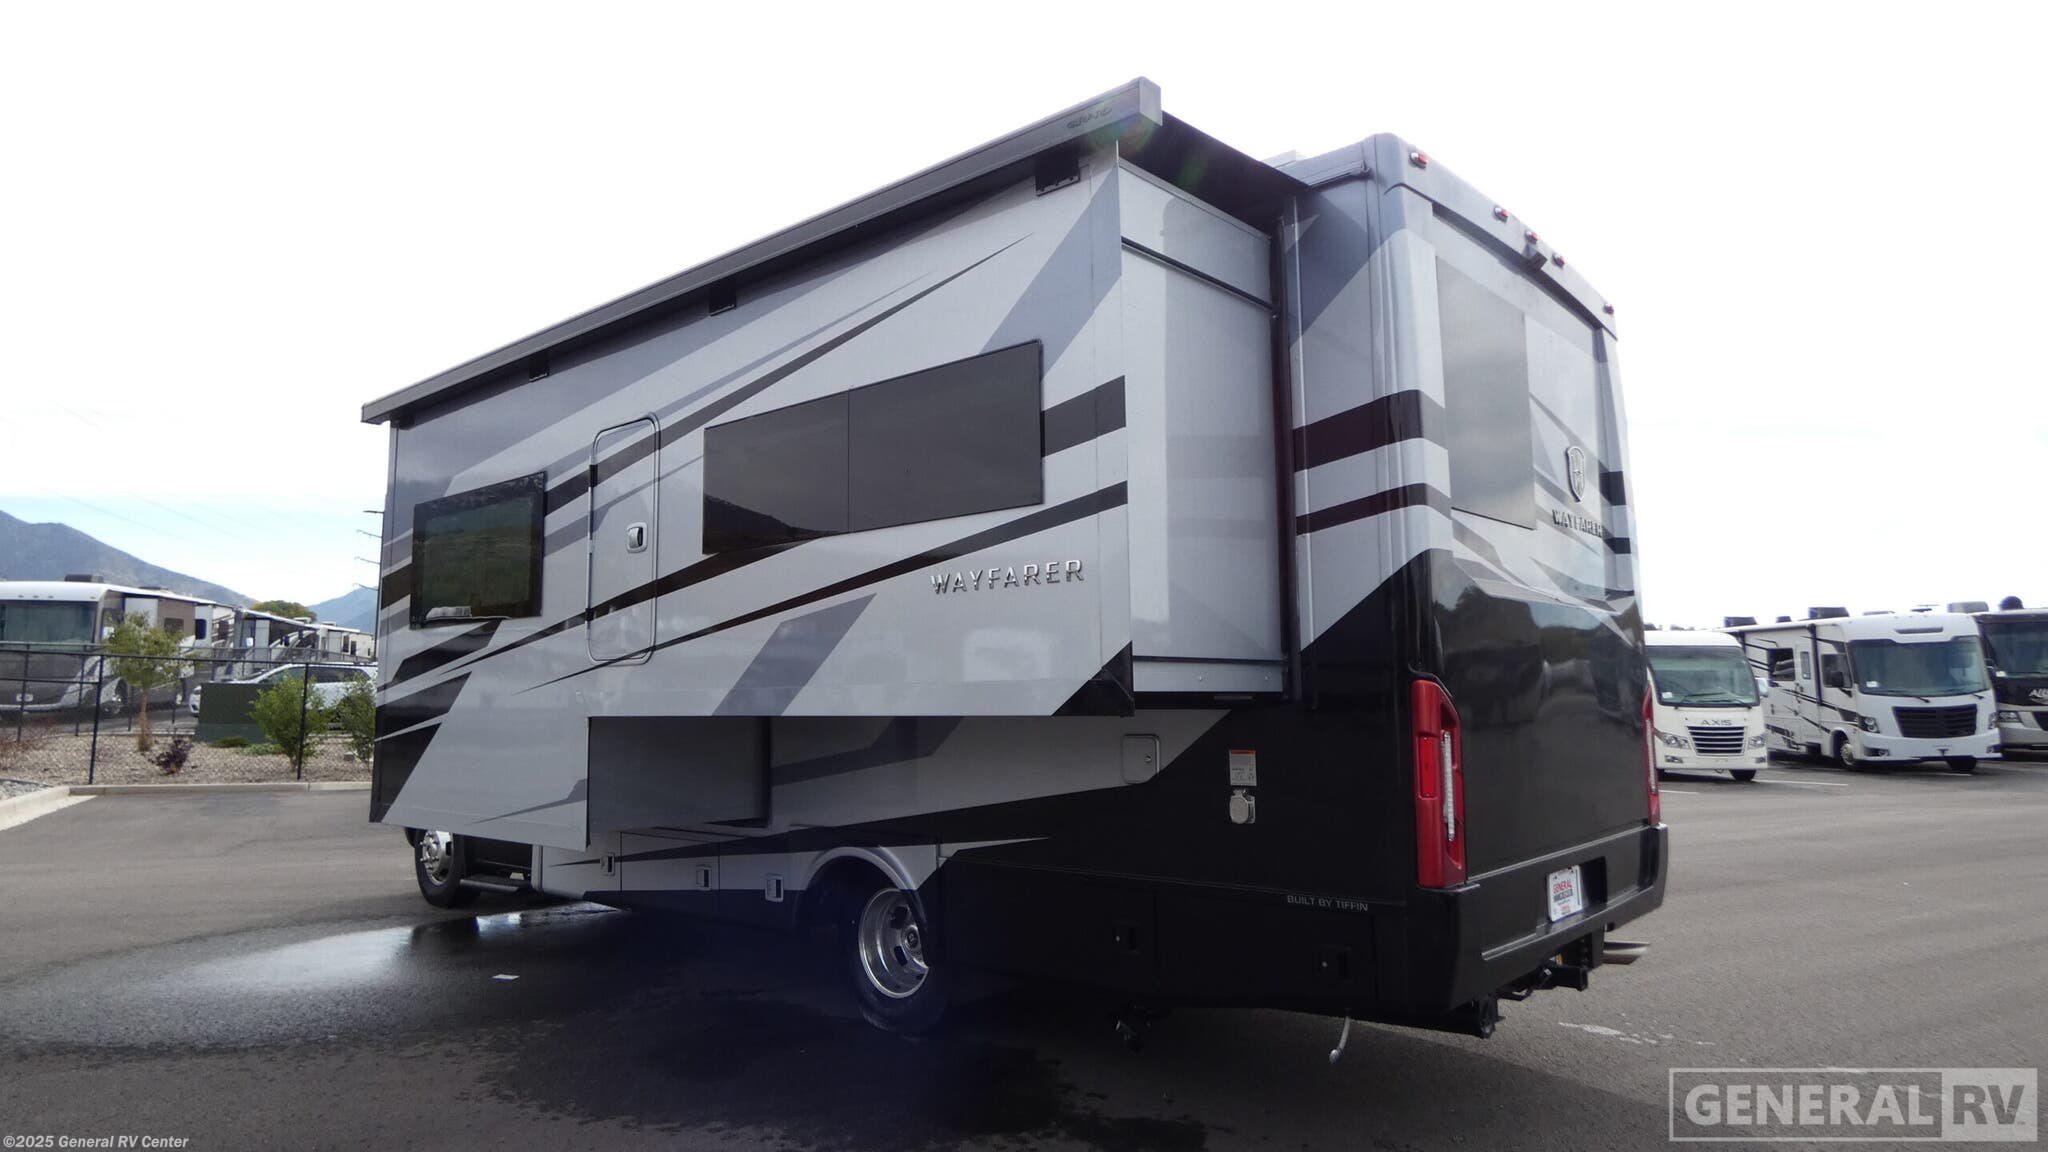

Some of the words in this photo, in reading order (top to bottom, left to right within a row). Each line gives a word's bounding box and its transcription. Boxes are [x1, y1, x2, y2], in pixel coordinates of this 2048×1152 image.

[1551, 508, 1603, 538] WAYFARER
[930, 559, 1085, 594] WAYFARER
[1287, 895, 1315, 905] BUILT
[1318, 898, 1331, 907] BY
[1335, 900, 1368, 911] TIFFIN
